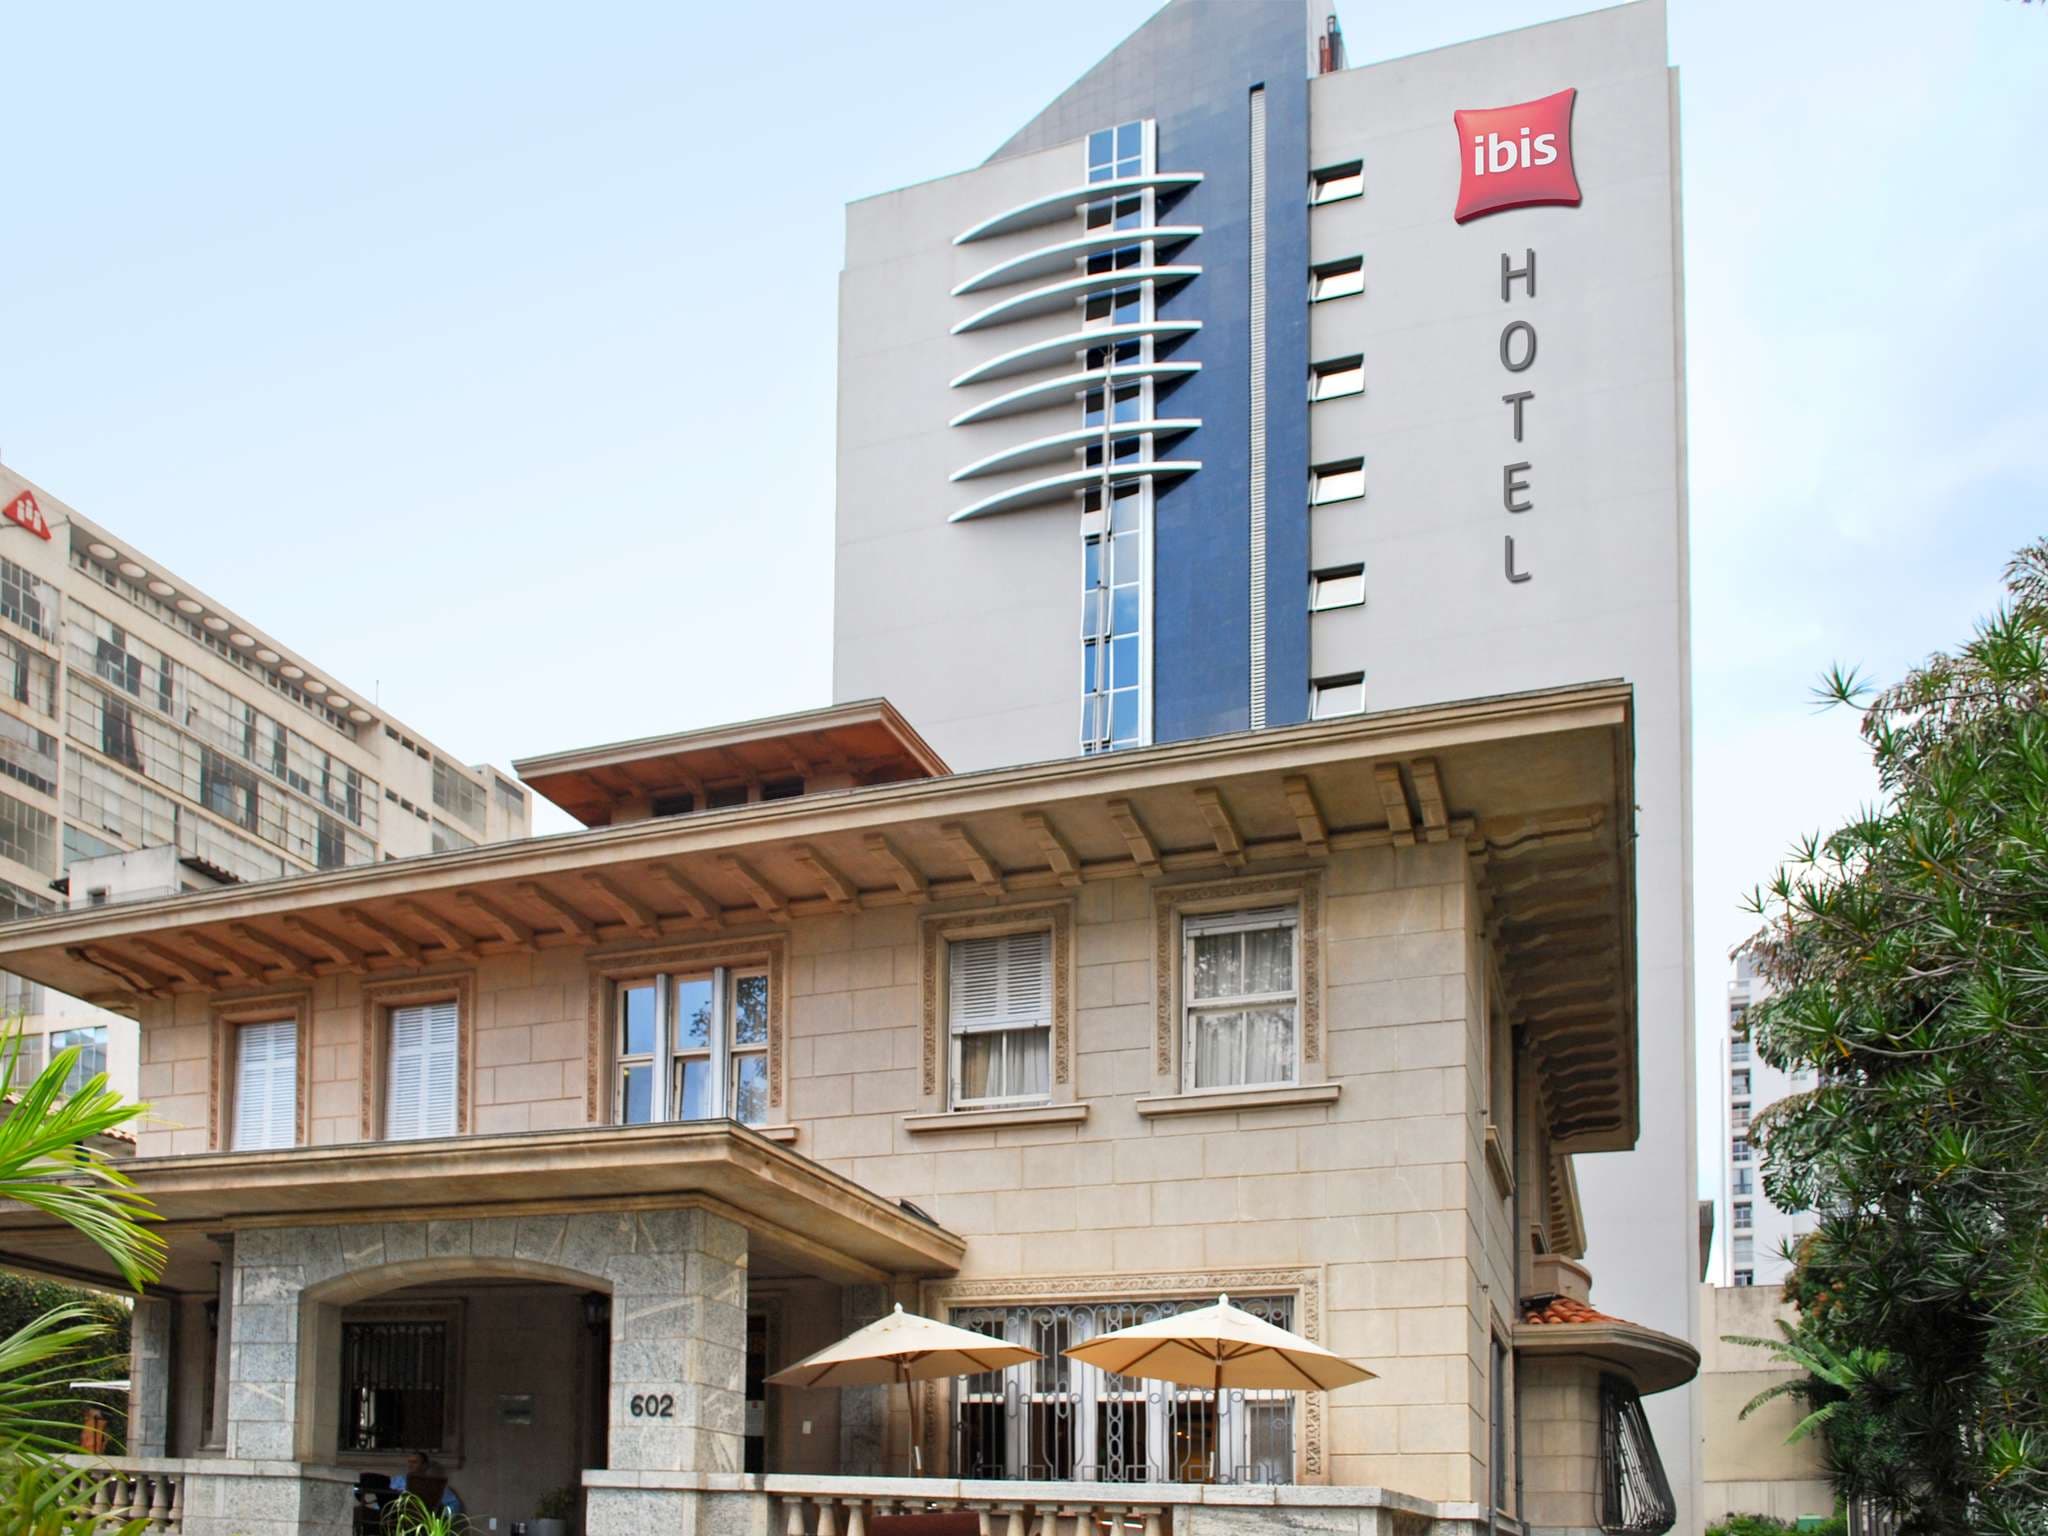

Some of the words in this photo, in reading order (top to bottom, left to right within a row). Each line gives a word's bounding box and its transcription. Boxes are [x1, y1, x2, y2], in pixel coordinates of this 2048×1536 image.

[1474, 127, 1557, 176] ibis
[1500, 248, 1537, 583] HOTEL
[631, 1394, 674, 1417] 602
